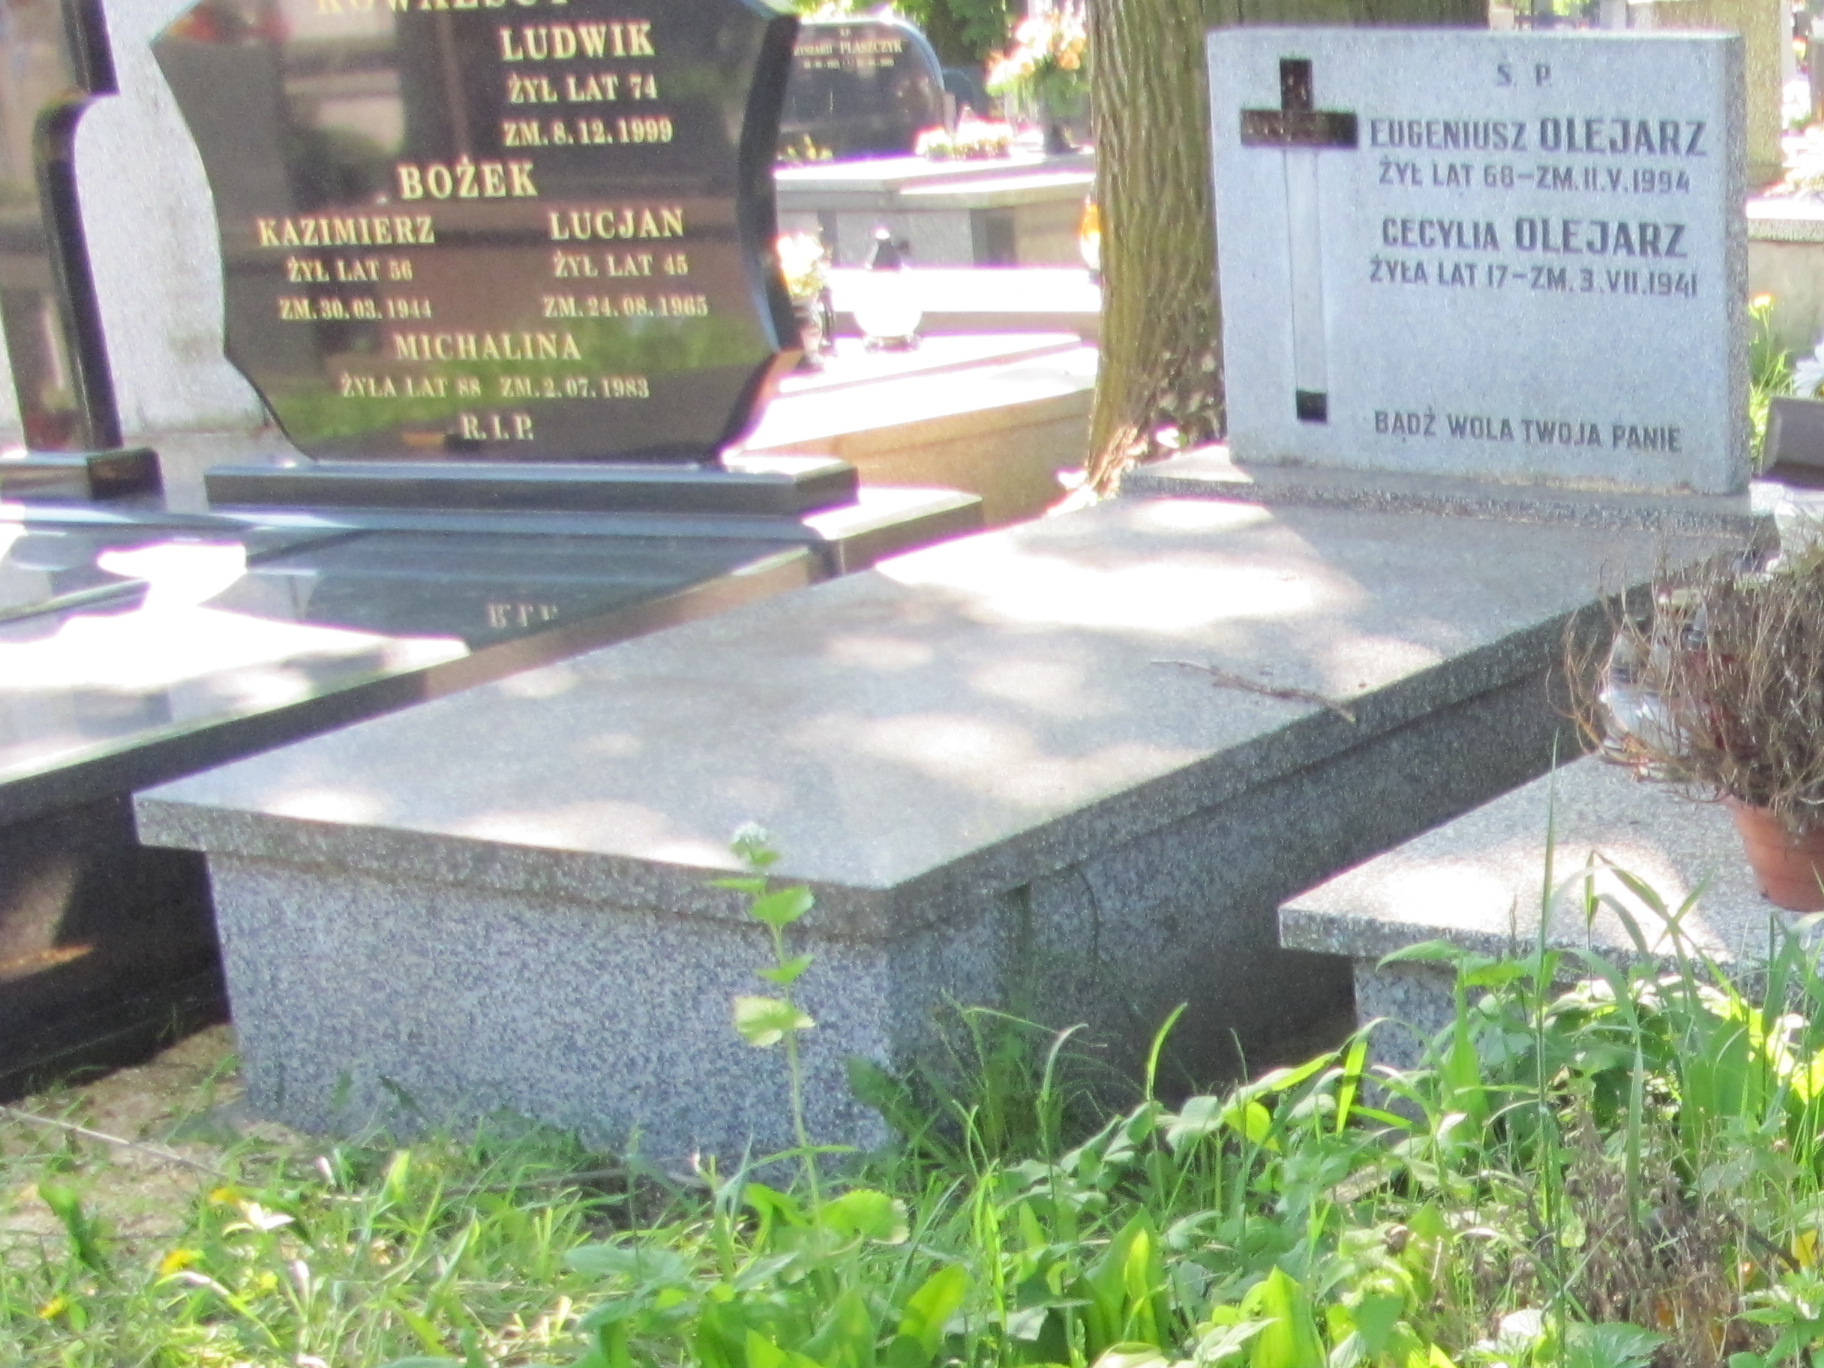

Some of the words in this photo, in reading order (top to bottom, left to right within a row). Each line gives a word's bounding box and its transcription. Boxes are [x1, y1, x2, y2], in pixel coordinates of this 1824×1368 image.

[501, 20, 656, 61] LUDWIK
[566, 72, 620, 102] LAT
[628, 73, 659, 100] 74
[1370, 118, 1527, 151] EUGENIUSZ
[1539, 117, 1708, 158] OLEJARZ
[398, 153, 538, 200] BOŻEK
[1379, 154, 1423, 186] ŻYŁ
[1432, 160, 1474, 189] LAT
[257, 214, 436, 247] KAZIMIERZ
[549, 206, 684, 241] LUCJAN
[1382, 216, 1500, 251] CECYLIA
[1514, 217, 1689, 259] OLEJARZ
[336, 259, 381, 282] LAT
[606, 253, 653, 277] LAT
[663, 253, 689, 277] 45
[1369, 253, 1428, 286] ŻYŁA
[1437, 259, 1478, 288] LAT
[394, 330, 582, 361] MICHALINA
[405, 375, 448, 399] LAT
[1374, 407, 1437, 443] BĄDŹ
[1446, 414, 1515, 443] WOLA
[1520, 417, 1604, 448] TWOJA
[1612, 423, 1684, 451] PANIE
